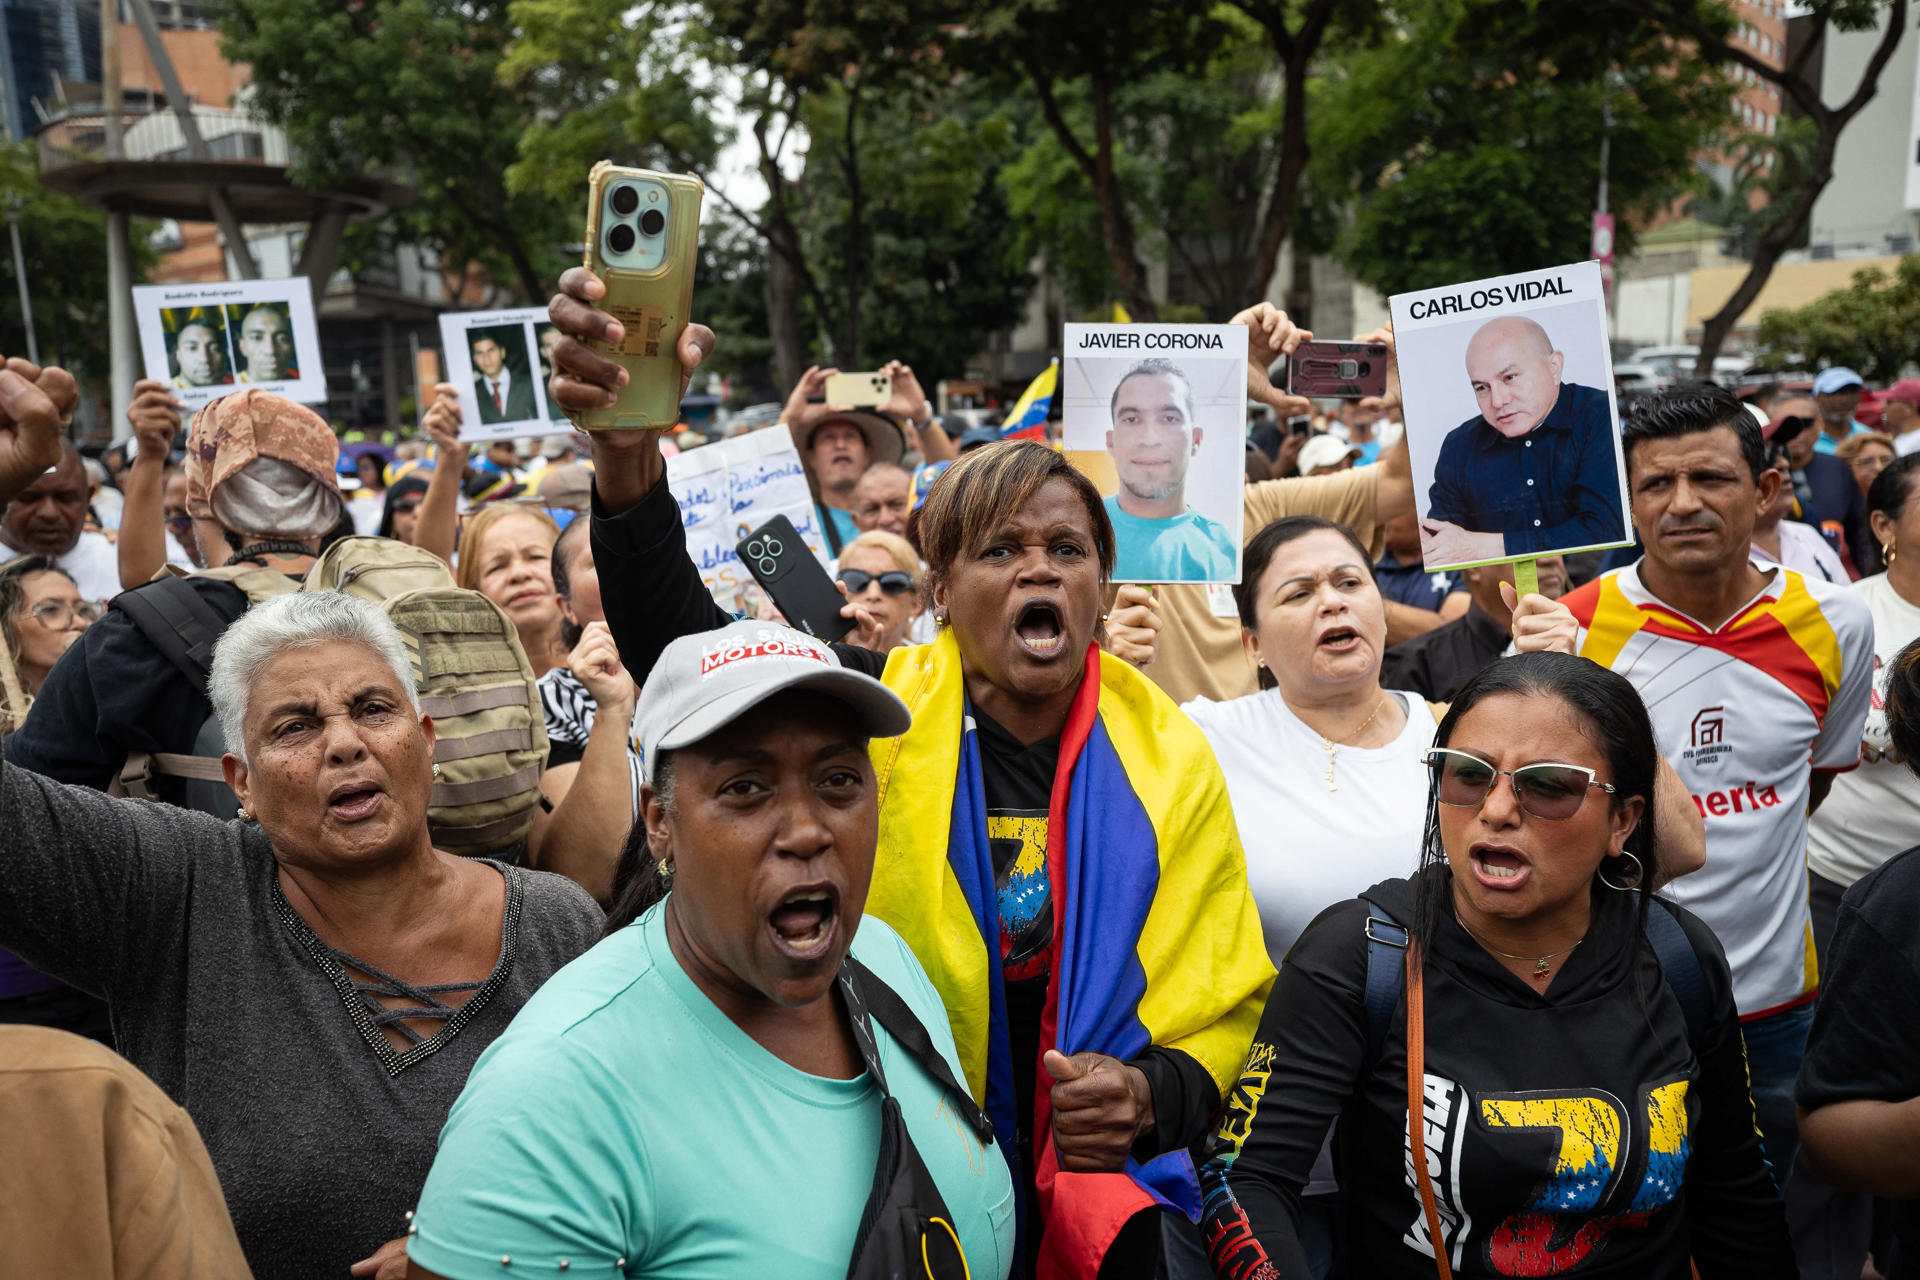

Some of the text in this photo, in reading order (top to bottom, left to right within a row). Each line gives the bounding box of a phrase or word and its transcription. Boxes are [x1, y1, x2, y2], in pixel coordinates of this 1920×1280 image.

[1410, 276, 1572, 320] CARLOS VIDAL
[1079, 333, 1223, 349] JAVIER CORONA
[703, 634, 746, 656] LOS
[703, 640, 814, 672] MOTORS
